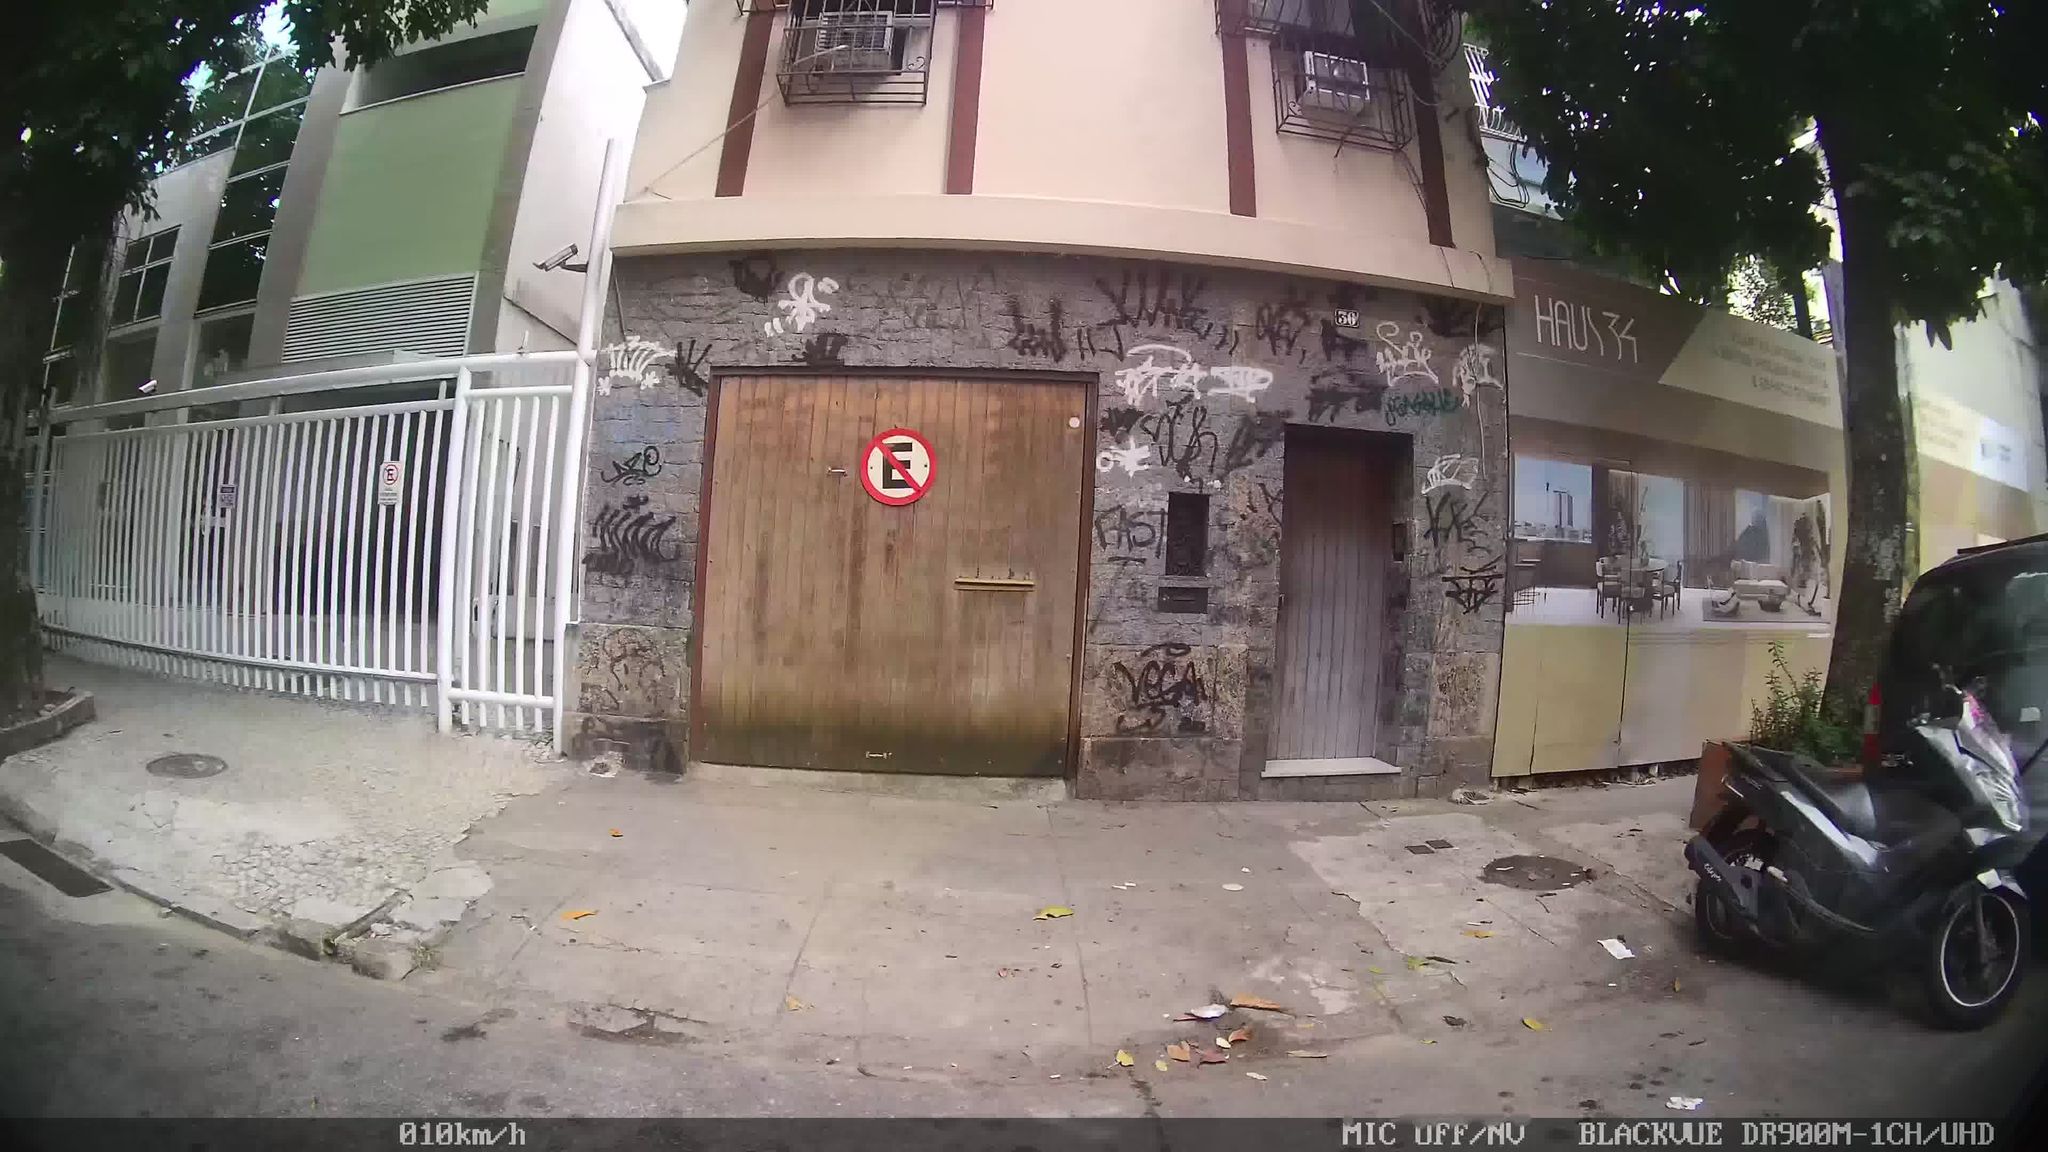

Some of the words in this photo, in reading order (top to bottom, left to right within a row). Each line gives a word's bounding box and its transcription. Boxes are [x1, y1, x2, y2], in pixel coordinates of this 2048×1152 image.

[1535, 295, 1604, 356] HAUS
[1602, 311, 1638, 363] 34
[882, 442, 914, 490] E
